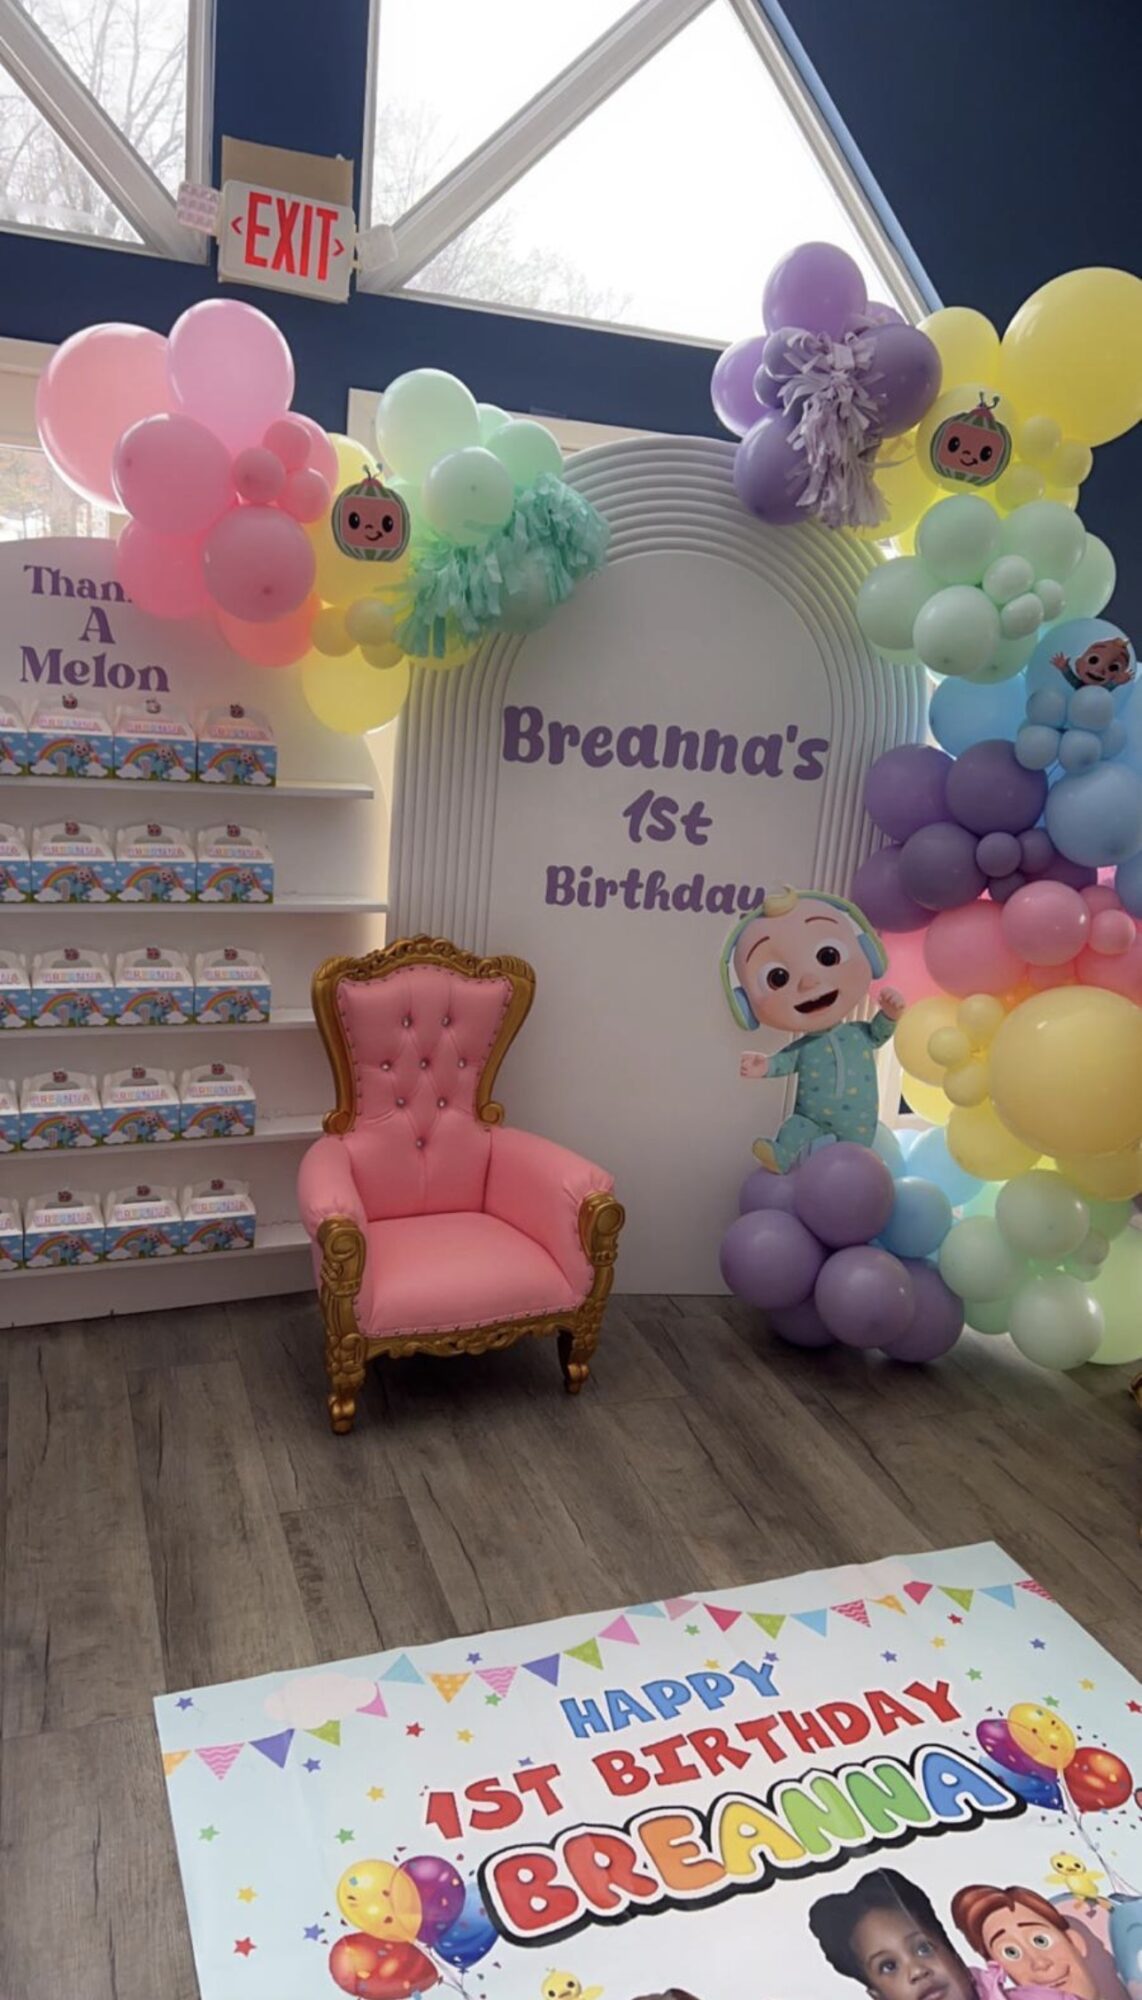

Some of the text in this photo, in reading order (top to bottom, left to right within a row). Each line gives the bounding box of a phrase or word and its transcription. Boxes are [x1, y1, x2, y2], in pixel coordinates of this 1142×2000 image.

[245, 191, 338, 281] EXIT
[24, 564, 132, 603] Than
[79, 605, 116, 644] A
[19, 646, 170, 692] Melon
[502, 705, 829, 781] Breanna's
[545, 864, 766, 920] Birthday
[560, 1660, 779, 1738] HAPPY
[426, 1680, 962, 1840] 1ST BIRTHDAY
[477, 1743, 1028, 1948] BREANNA
